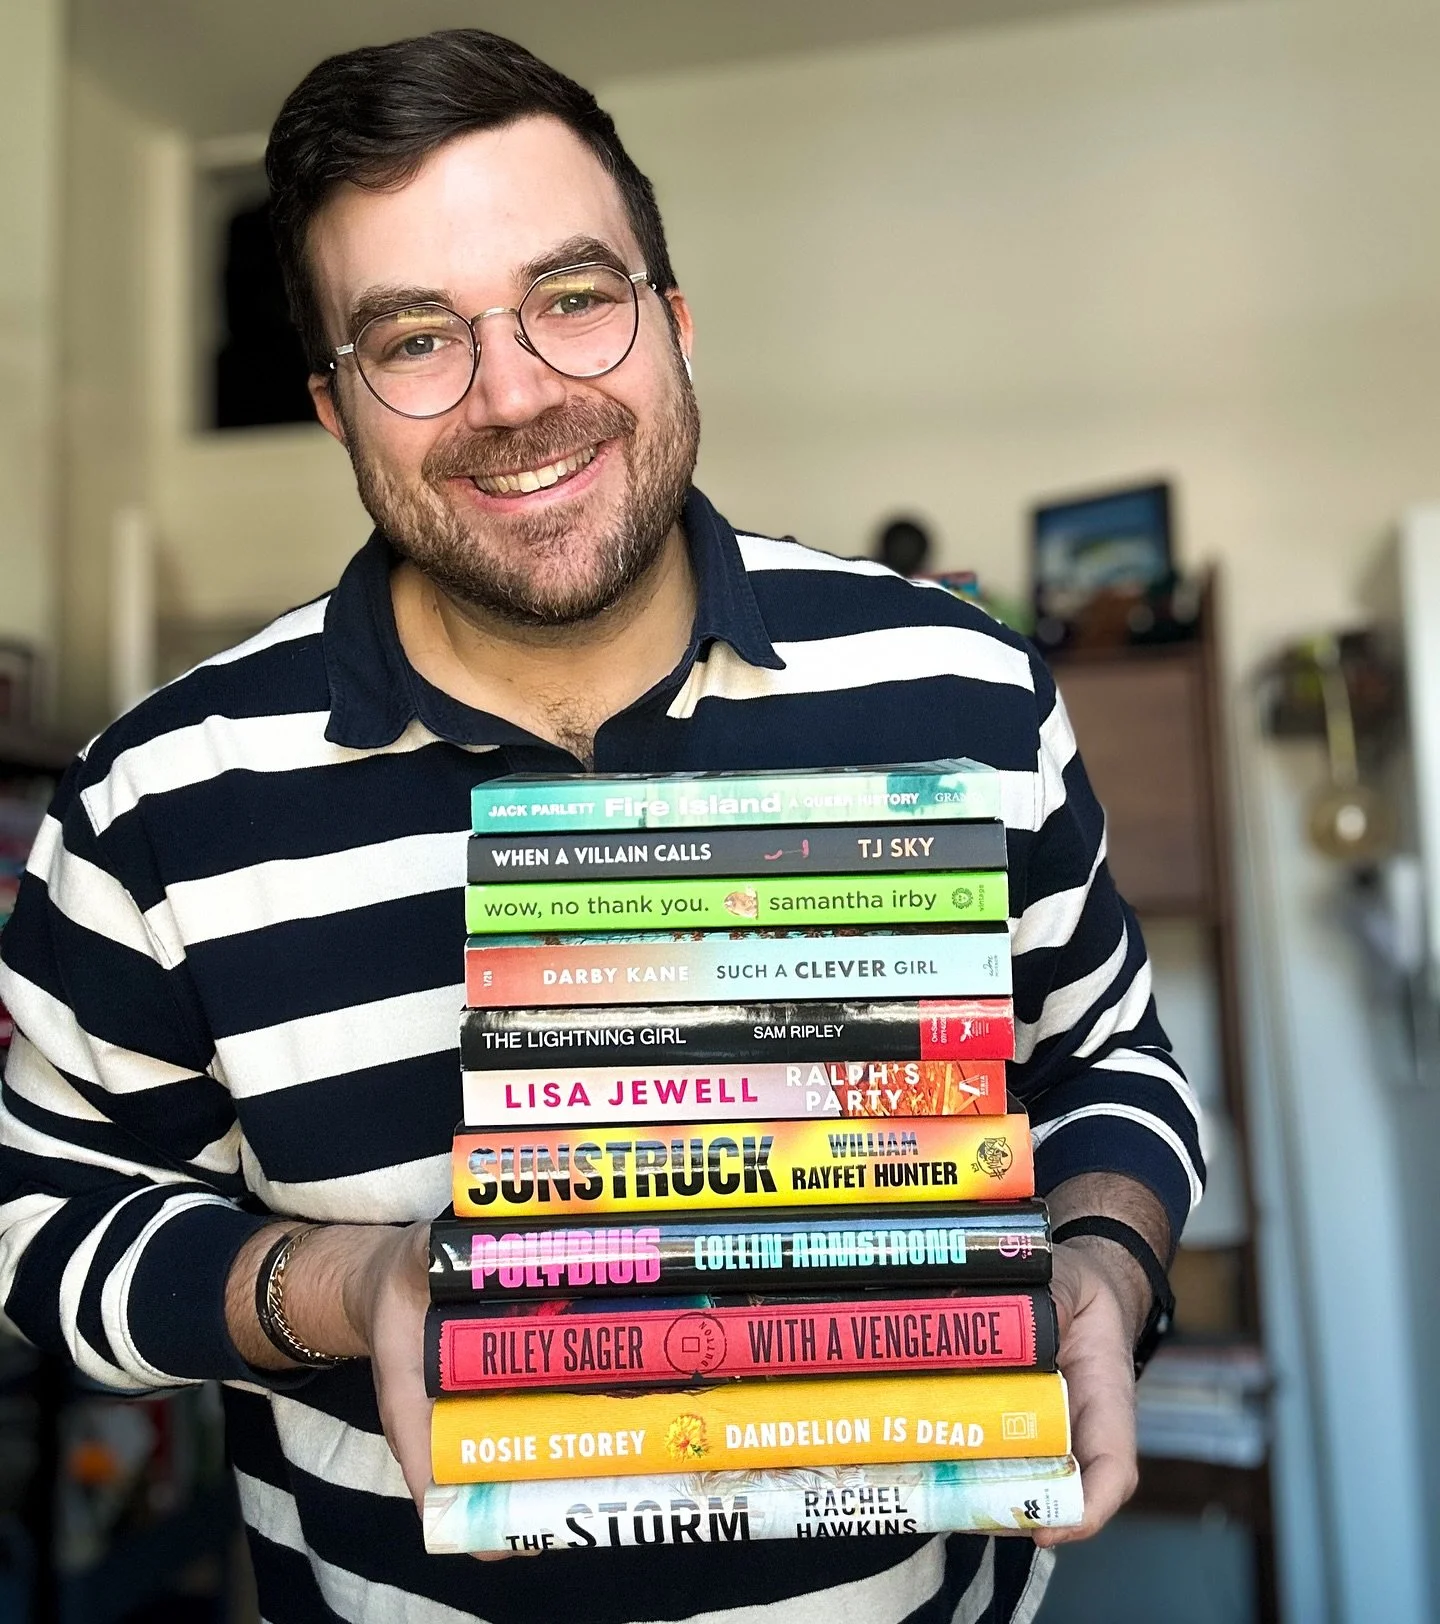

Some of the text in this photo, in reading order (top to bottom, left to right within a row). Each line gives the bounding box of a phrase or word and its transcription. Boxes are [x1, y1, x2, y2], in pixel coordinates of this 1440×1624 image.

[488, 802, 595, 818] JACK PARLETT
[605, 791, 782, 818] Fire Island
[491, 843, 712, 867] WHEN A VILLAIN CALLS
[857, 836, 934, 858] TJ SKY
[484, 895, 709, 919] wow, no thank you.
[769, 889, 937, 911] samantha irby
[543, 966, 689, 985] DARBY KANE
[716, 959, 938, 980] SUCH A CLEVER GIRL
[482, 1027, 686, 1049] THE LIGHTNING GIRL
[753, 1024, 844, 1040] SAM RIPLEY
[786, 1063, 921, 1087] RALPH'S
[505, 1077, 758, 1109] LISA JEWELL
[805, 1089, 904, 1112] PARTY
[828, 1131, 919, 1159] WILLIAM
[468, 1135, 777, 1206] SUNSTRUCK
[792, 1161, 958, 1190] RAYFET HUNTER
[471, 1228, 661, 1290] POLYBIUS
[694, 1228, 967, 1271] COLLIN ARMSTRONG
[482, 1325, 644, 1376] RILEY SAGER
[748, 1311, 1003, 1364] WITH A VENGEANCE
[725, 1416, 984, 1450] DANDELION IS DEAD
[460, 1429, 647, 1465] ROSIE STOREY
[804, 1486, 908, 1518] RACHEL
[505, 1496, 749, 1551] THE STORM
[796, 1518, 918, 1538] HAWKINS
